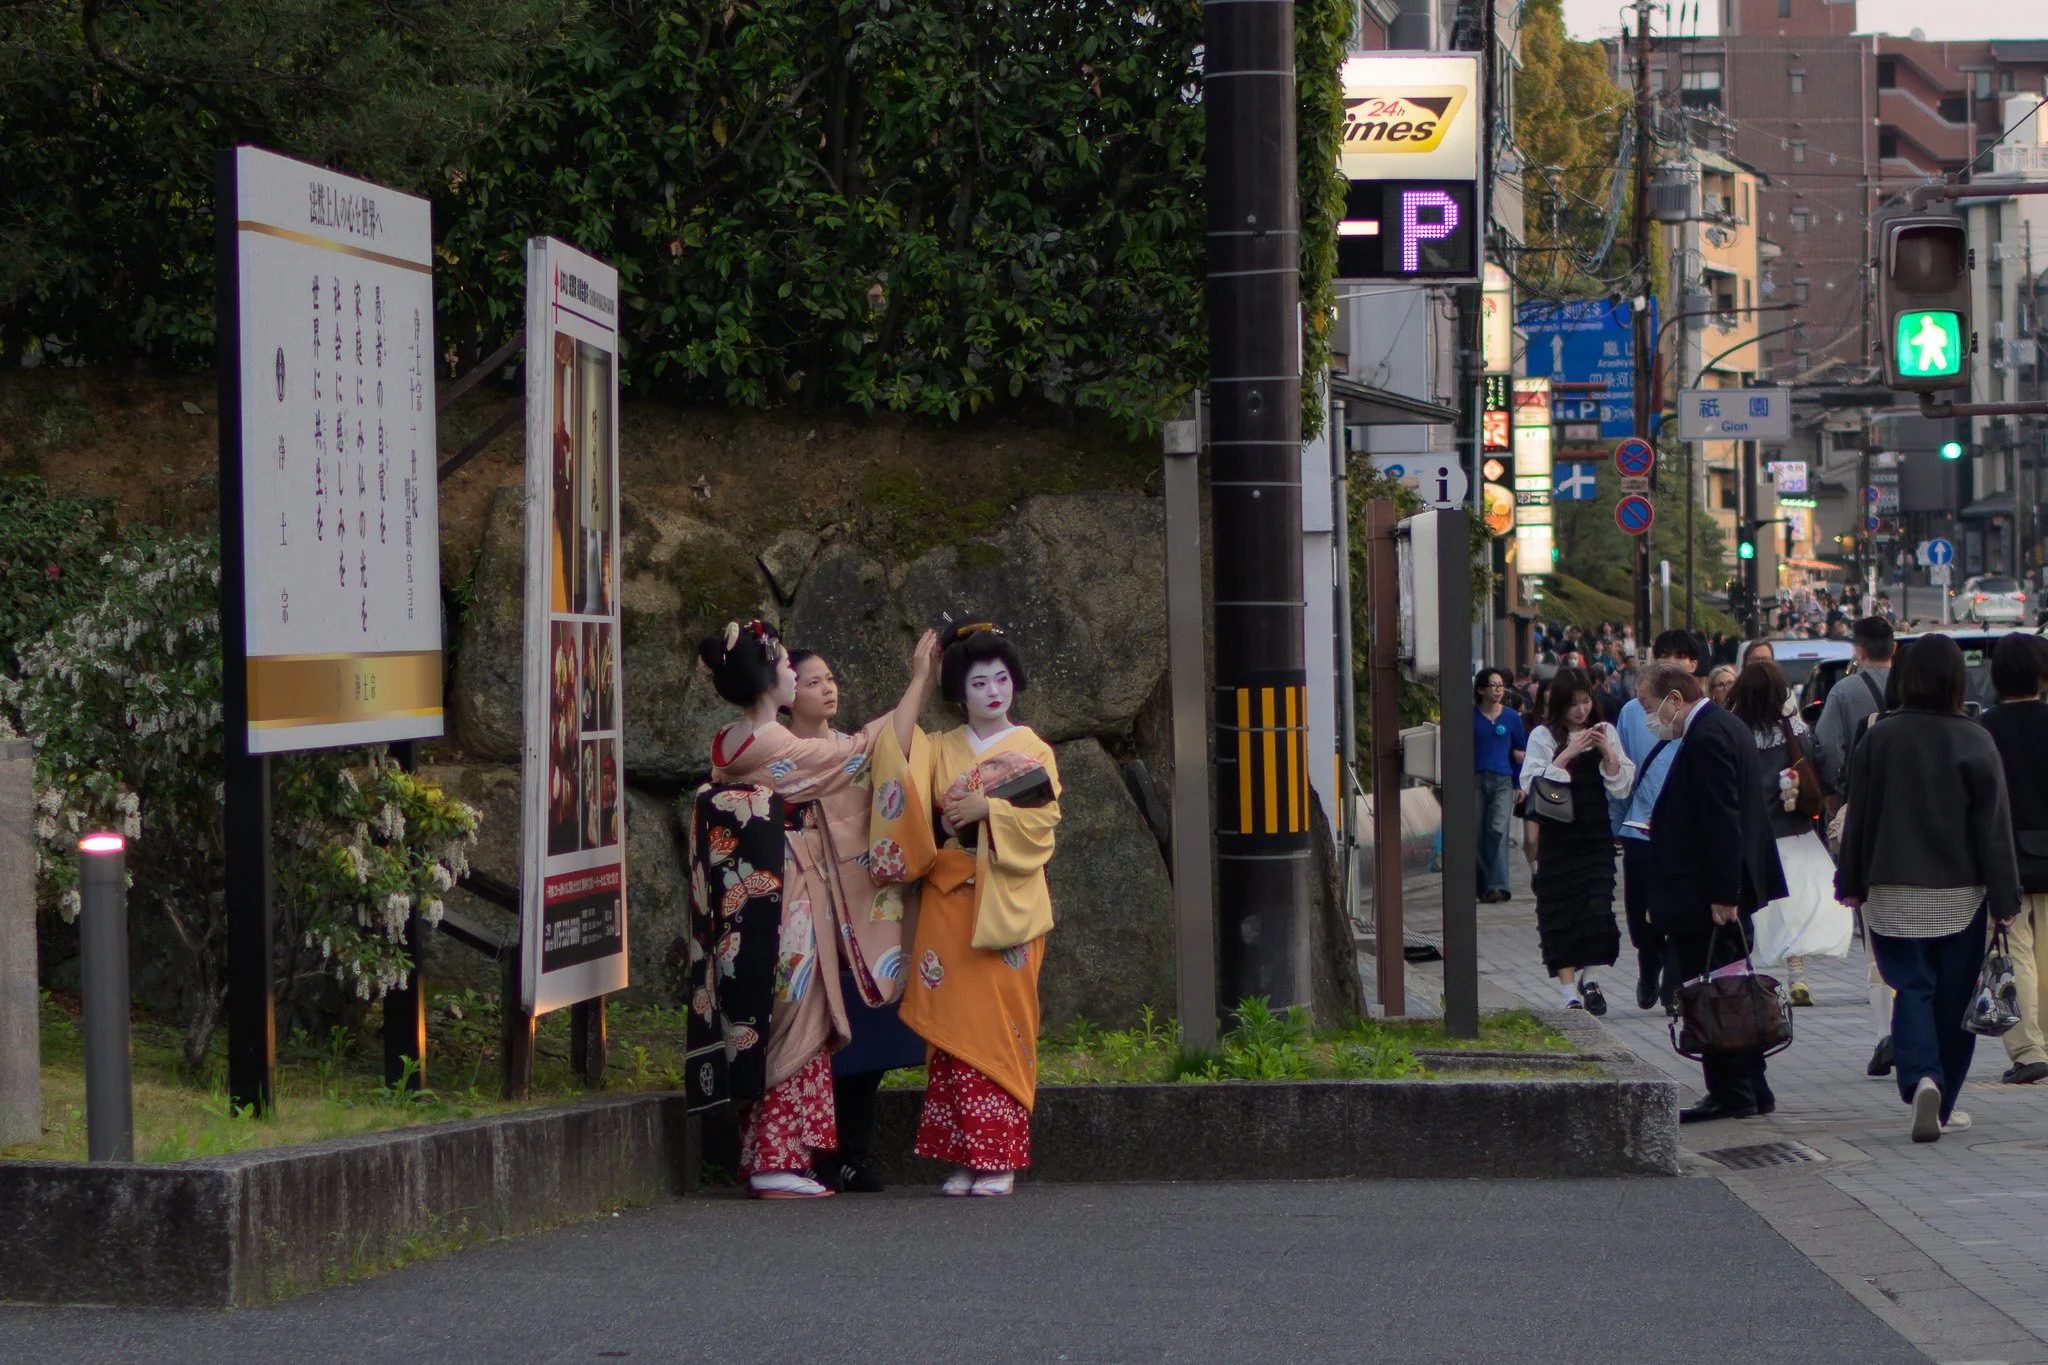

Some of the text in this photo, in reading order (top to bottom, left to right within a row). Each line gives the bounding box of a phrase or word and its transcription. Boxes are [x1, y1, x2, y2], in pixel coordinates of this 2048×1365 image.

[309, 181, 383, 240] 法然上人の心を世界へ
[1343, 113, 1437, 142] imes
[1401, 191, 1459, 272] P
[312, 275, 324, 540] 世界に共生を
[333, 277, 346, 587] 社会に慈しみを
[353, 280, 368, 631] 家庭にみ仏の光を
[375, 286, 386, 543] 愚者の自覚を
[1721, 421, 1749, 432] Gion
